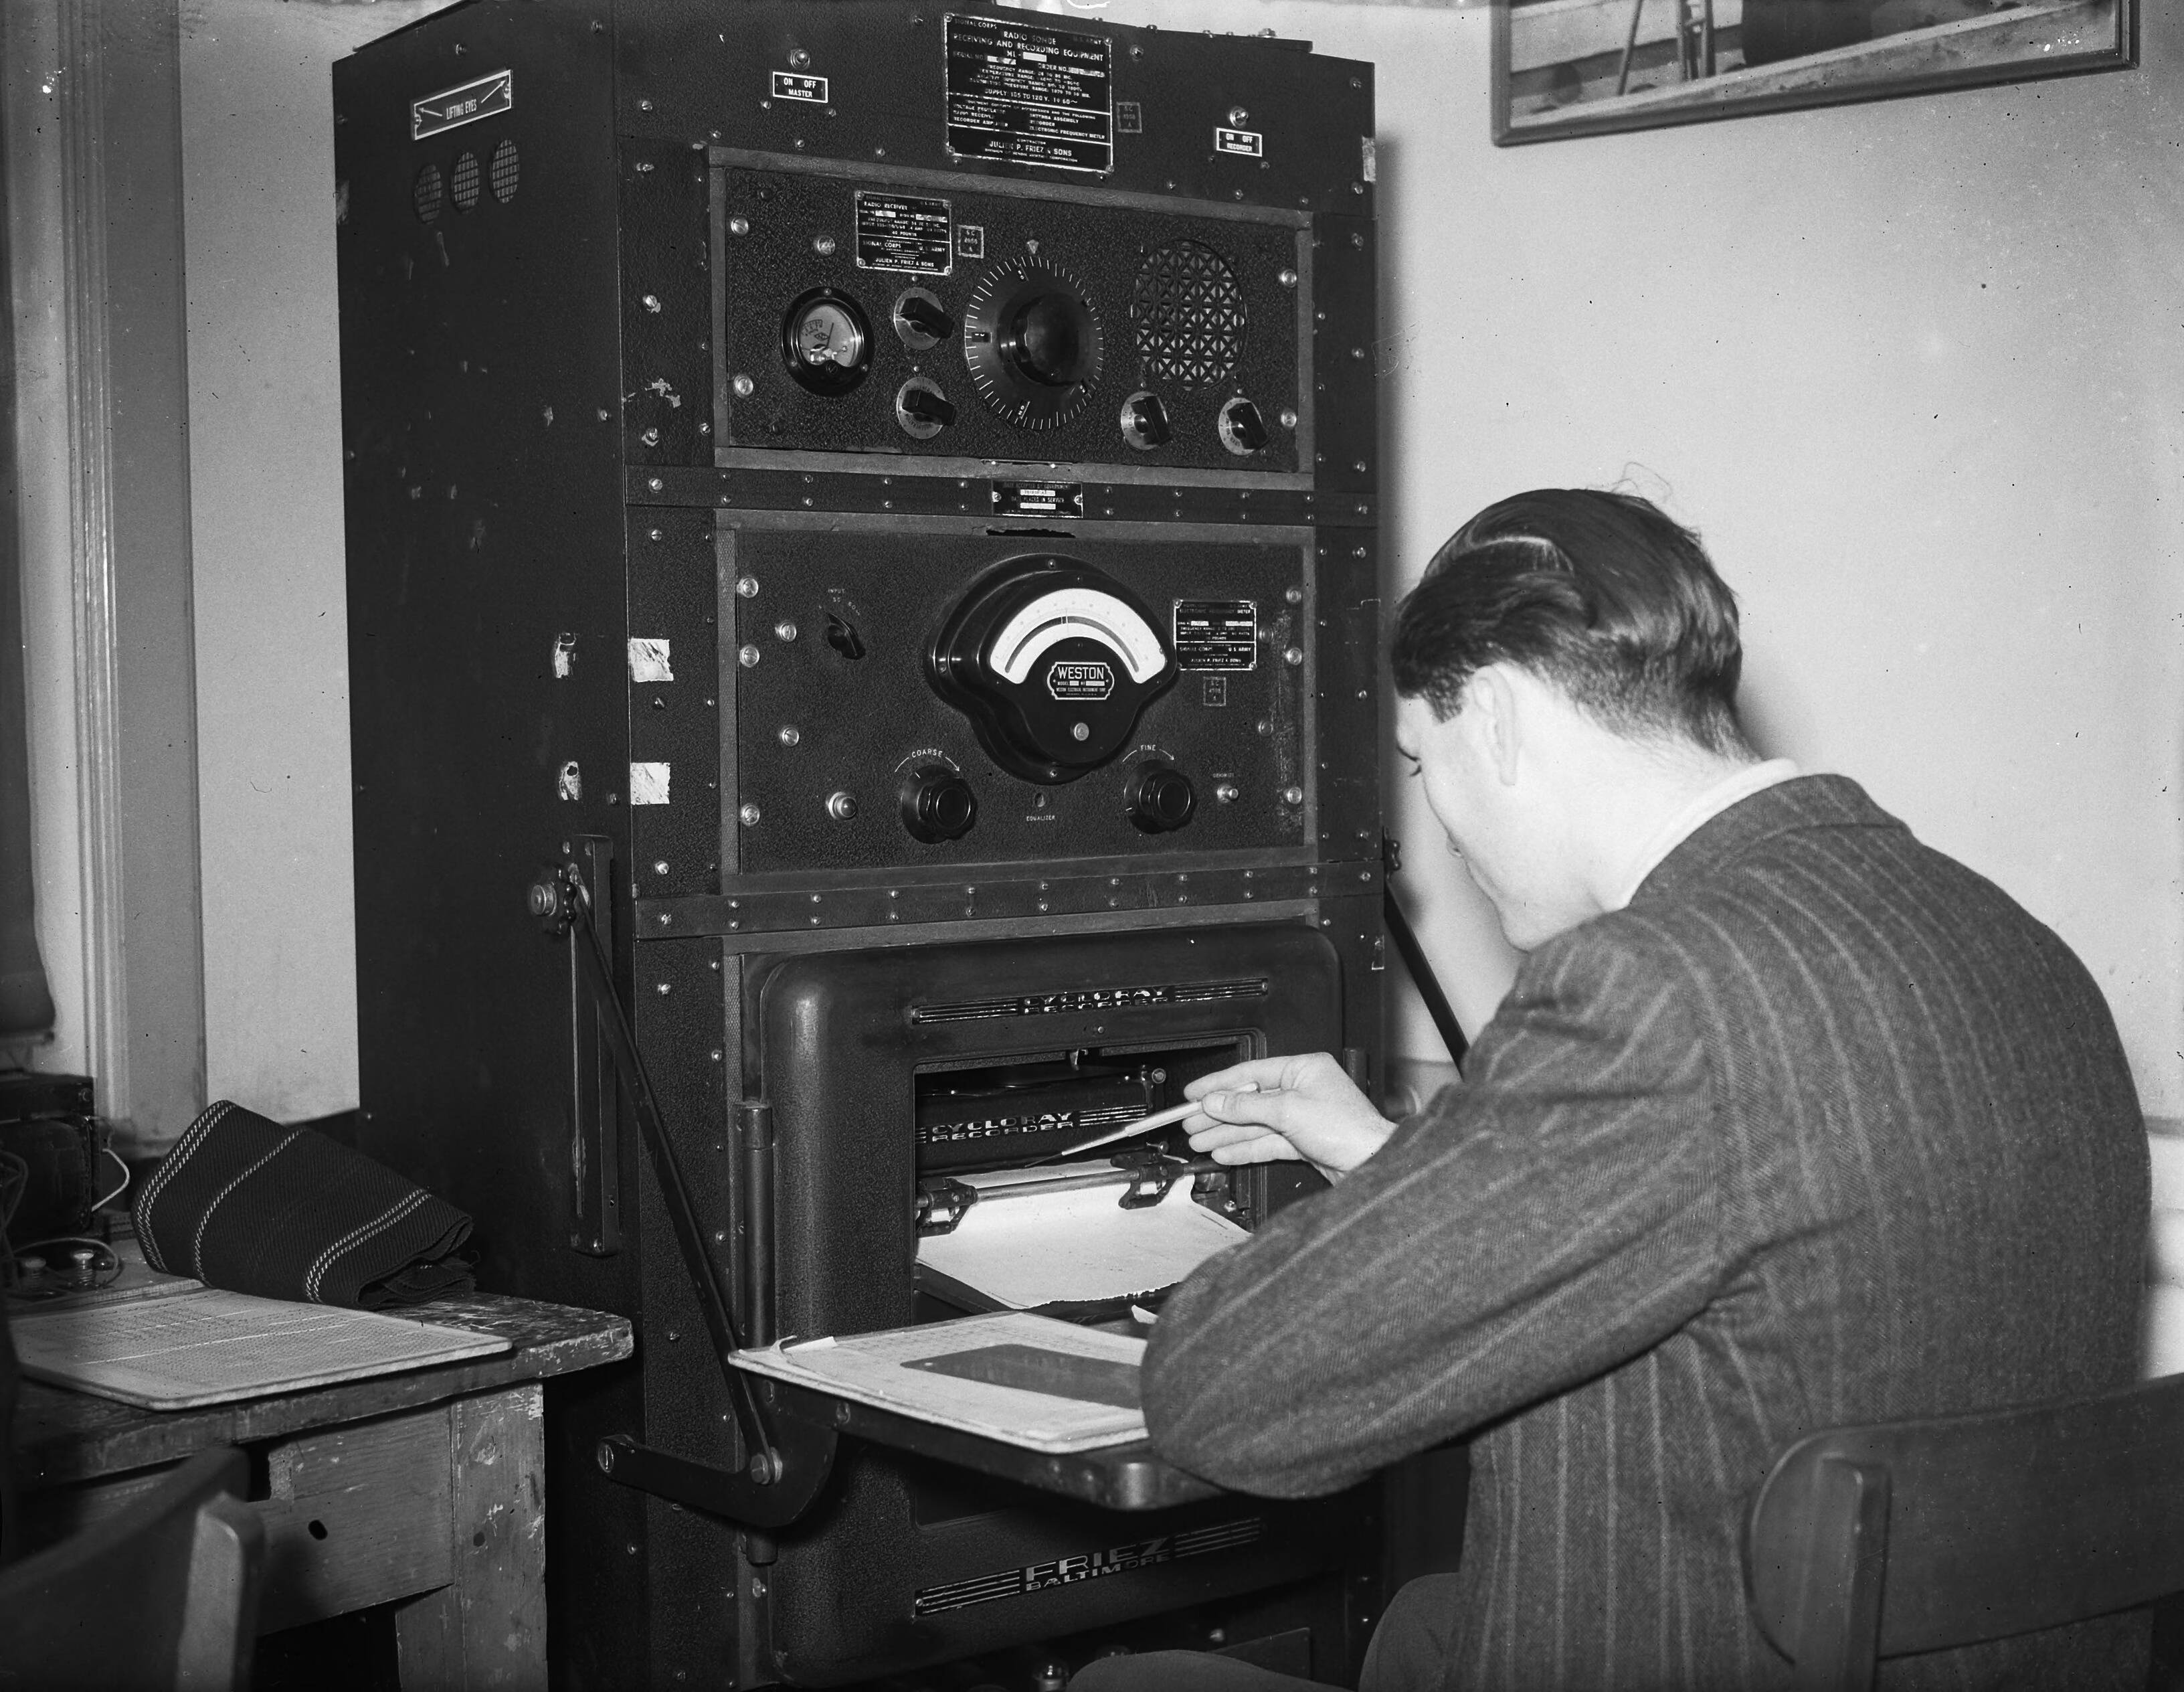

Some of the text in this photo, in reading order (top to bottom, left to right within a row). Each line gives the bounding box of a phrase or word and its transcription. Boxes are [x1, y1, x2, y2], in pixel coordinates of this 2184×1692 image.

[978, 21, 997, 29] CORPS
[1004, 30, 1027, 41] RADIO
[953, 33, 1103, 61] RECEIVING AND RECORDING EQUIPMENT
[784, 78, 816, 88] ON OFF
[788, 89, 812, 98] MASTER
[984, 88, 1008, 99] SUPPLY
[1023, 93, 1030, 102] TO
[446, 98, 477, 120] LIFTING EYES
[1053, 116, 1079, 124] ASSEMBLY
[1059, 129, 1087, 137] FREQUENCY
[1226, 133, 1253, 143] ON OFF
[1024, 144, 1044, 153] FRIEZ
[1053, 147, 1072, 157] SONS
[1226, 143, 1252, 152] RECORDER
[883, 202, 907, 210] RECEIVER
[1057, 667, 1103, 679] WESTON
[911, 748, 943, 758] COARSE
[1024, 989, 1165, 1005] CYCLORAY
[1024, 997, 1168, 1013] RECORDER
[932, 1112, 1072, 1134] CYCLORAY
[932, 1121, 1073, 1142] RECORDER
[1026, 1537, 1170, 1582] FRIEZ
[1026, 1552, 1170, 1591] BALTIMORE
